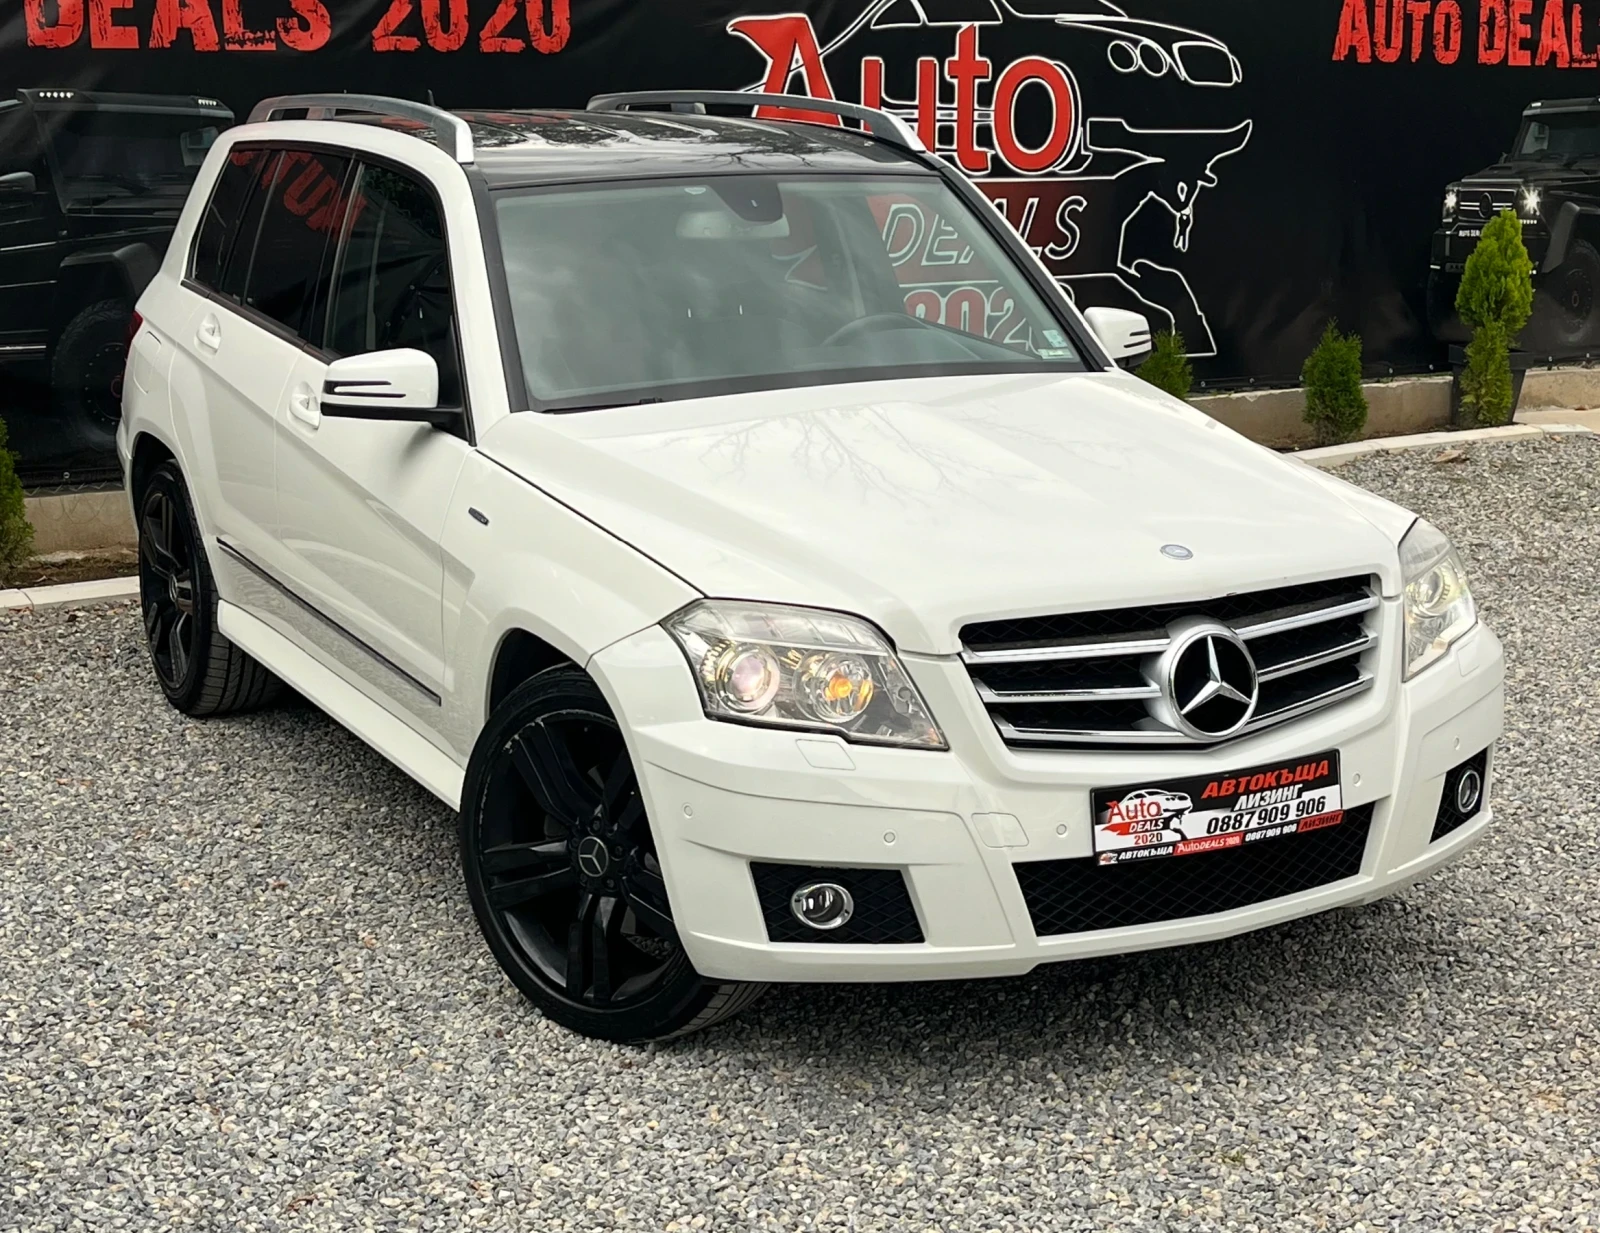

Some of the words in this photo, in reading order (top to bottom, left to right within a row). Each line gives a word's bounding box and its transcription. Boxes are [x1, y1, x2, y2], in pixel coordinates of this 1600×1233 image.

[1332, 0, 1462, 65] AUTO
[1478, 0, 1600, 68] DEAL
[726, 14, 1082, 174] Auto
[882, 195, 1088, 266] DELS
[1201, 760, 1329, 799] АВТОКЪЩА
[1105, 798, 1163, 823] Auto
[1233, 784, 1303, 811] ЛИЗИНГ
[1296, 796, 1326, 817] 906
[1129, 819, 1164, 833] DEALS
[1134, 832, 1163, 845] 2020
[1119, 846, 1173, 860] АВТОКЪЩА
